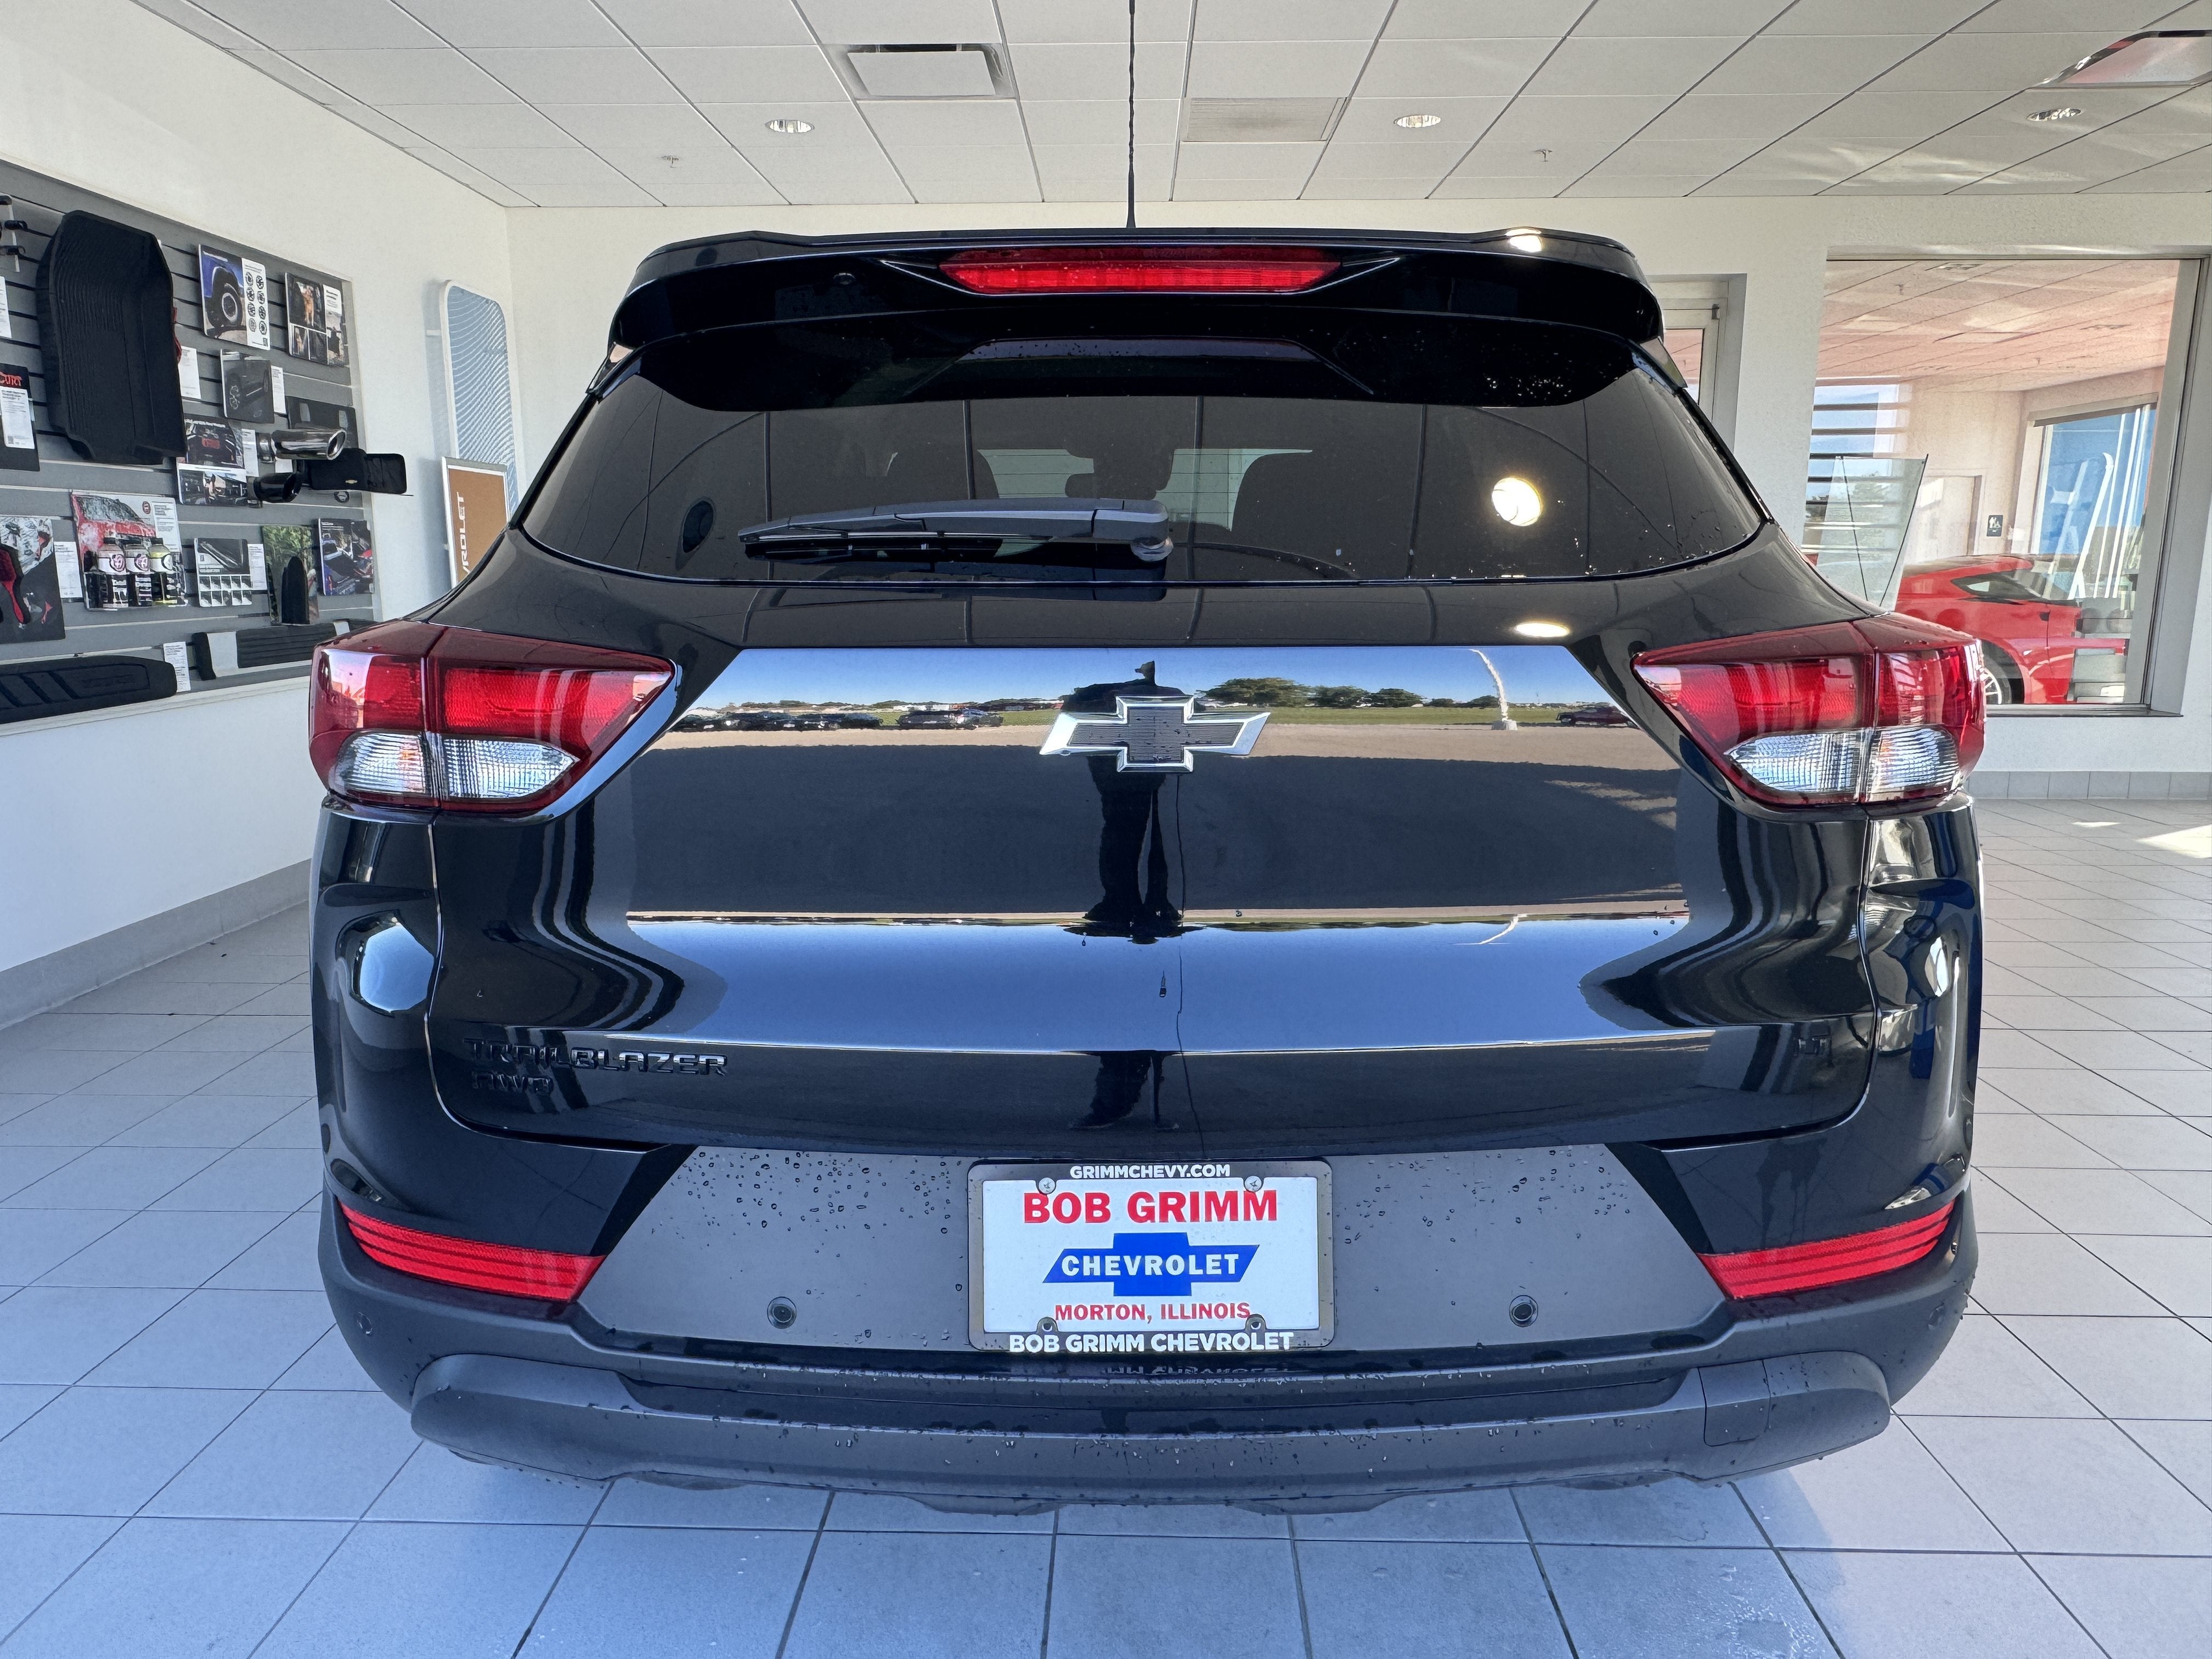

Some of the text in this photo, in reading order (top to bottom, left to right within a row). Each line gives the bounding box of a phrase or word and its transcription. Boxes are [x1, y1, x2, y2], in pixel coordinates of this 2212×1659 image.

[463, 1038, 728, 1076] TRAILBLAZER
[1070, 1164, 1230, 1179] GRIMMCHEVY.COM
[1024, 1190, 1277, 1223] BOB GRIMM
[1062, 1254, 1239, 1276] CHEVROLET
[1055, 1302, 1250, 1324] MORTON, ILLINOIS
[1009, 1331, 1294, 1353] BOB GRIMM CHEVROLET
